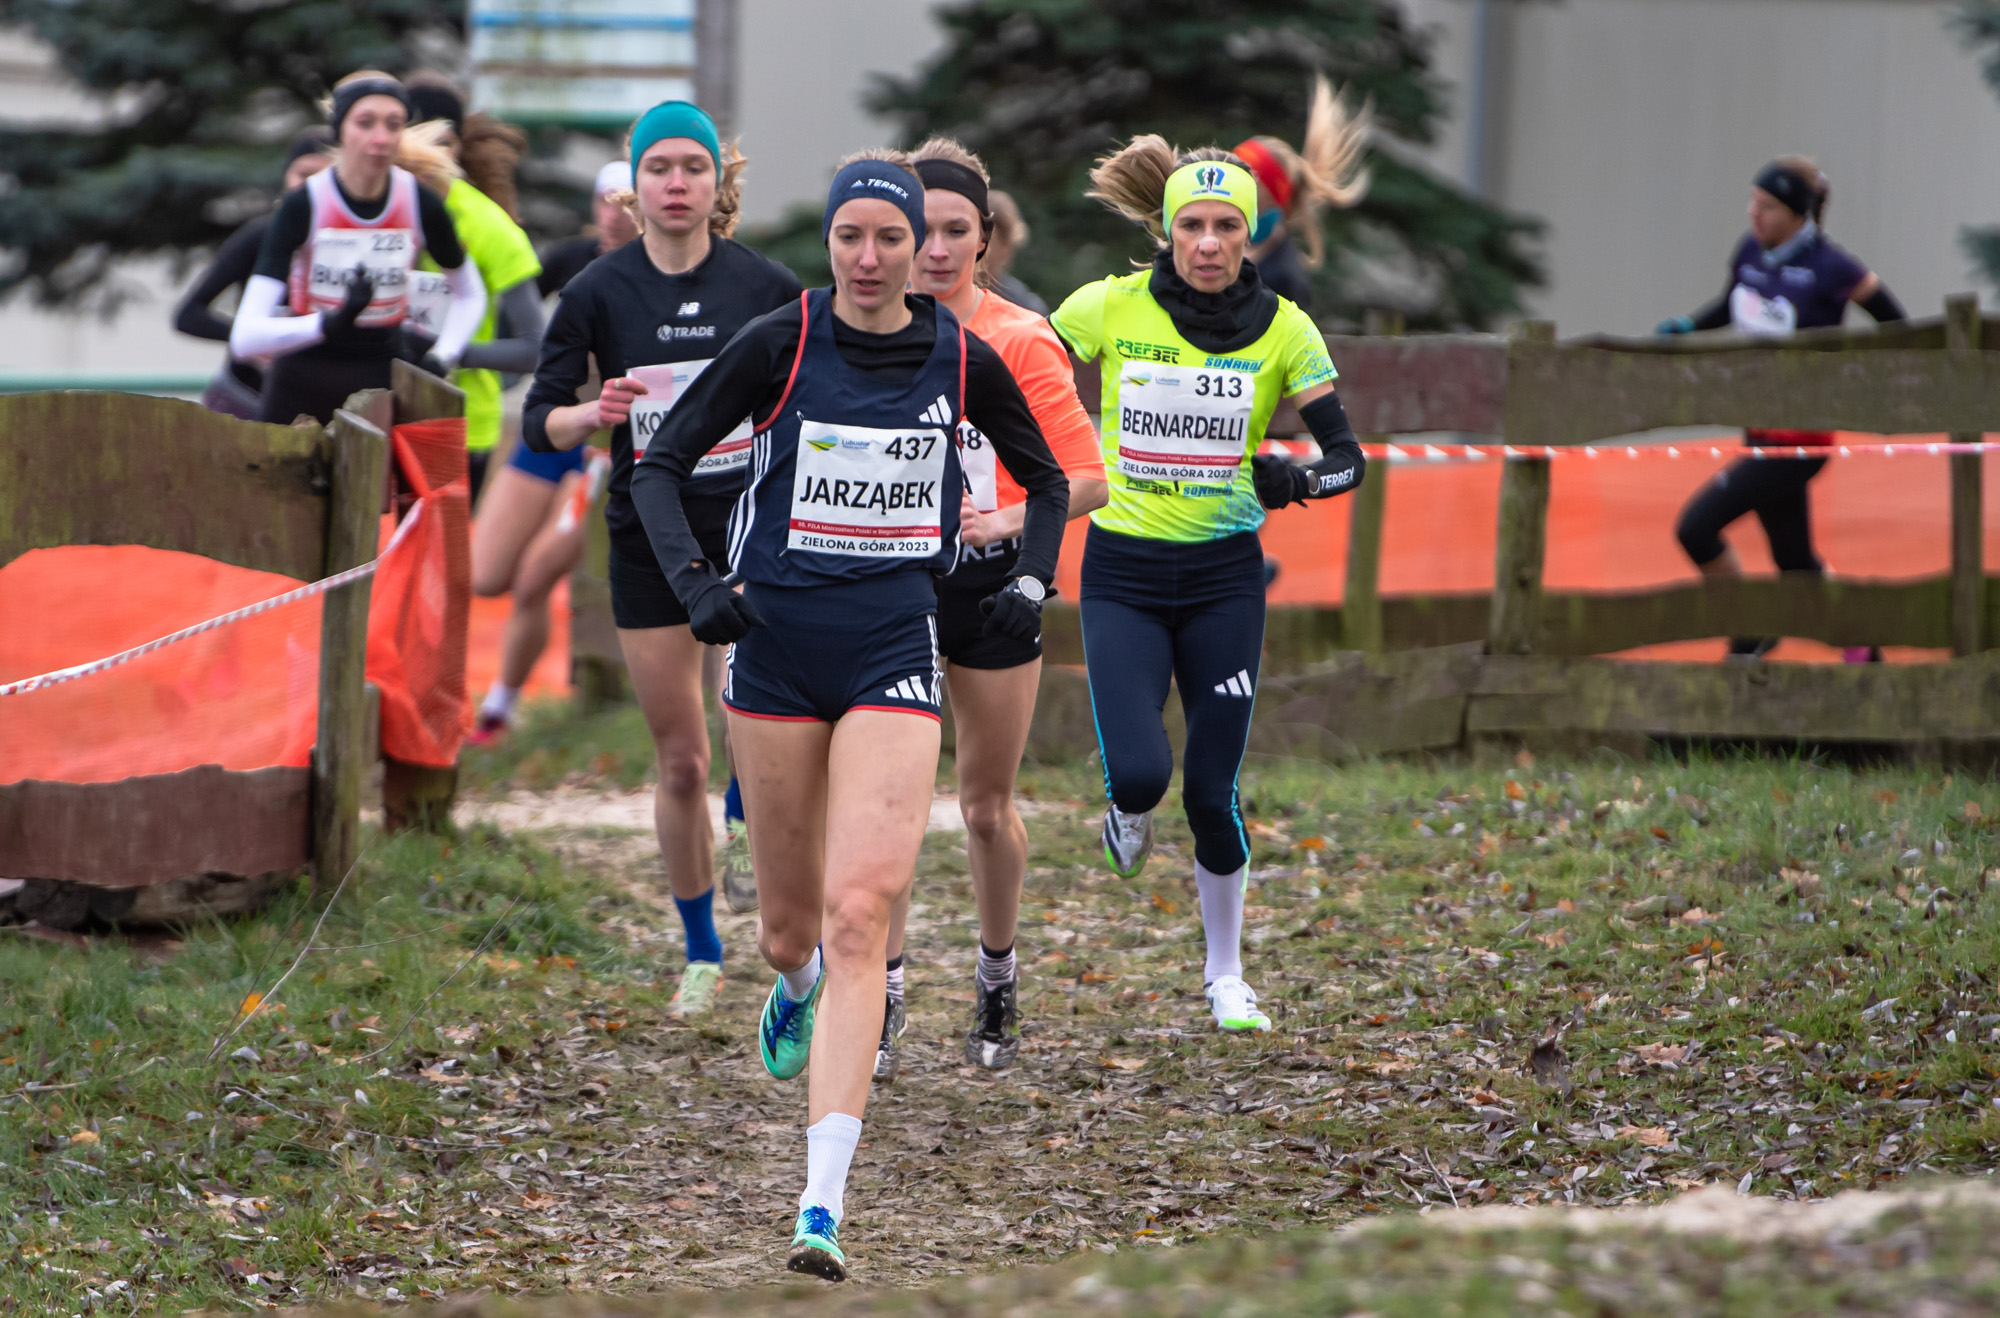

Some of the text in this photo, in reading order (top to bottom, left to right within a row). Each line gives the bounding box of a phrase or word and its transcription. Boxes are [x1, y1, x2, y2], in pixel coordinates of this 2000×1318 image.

[867, 178, 909, 200] TERREX
[674, 326, 715, 337] TRADE
[1195, 374, 1242, 398] 313
[1122, 407, 1244, 441] BERNARDELLI
[885, 436, 937, 460] 437
[698, 452, 750, 468] GÓRA 202
[1123, 461, 1232, 478] ZIELONA GÓRA 2023
[1320, 466, 1355, 489] TERREX
[799, 476, 936, 516] JARZĄBEK
[807, 522, 820, 530] PZLA
[821, 524, 854, 533] Mistrzostwa
[878, 528, 899, 536] Biegach
[801, 536, 929, 552] ZIELONA GÓRA 2023
